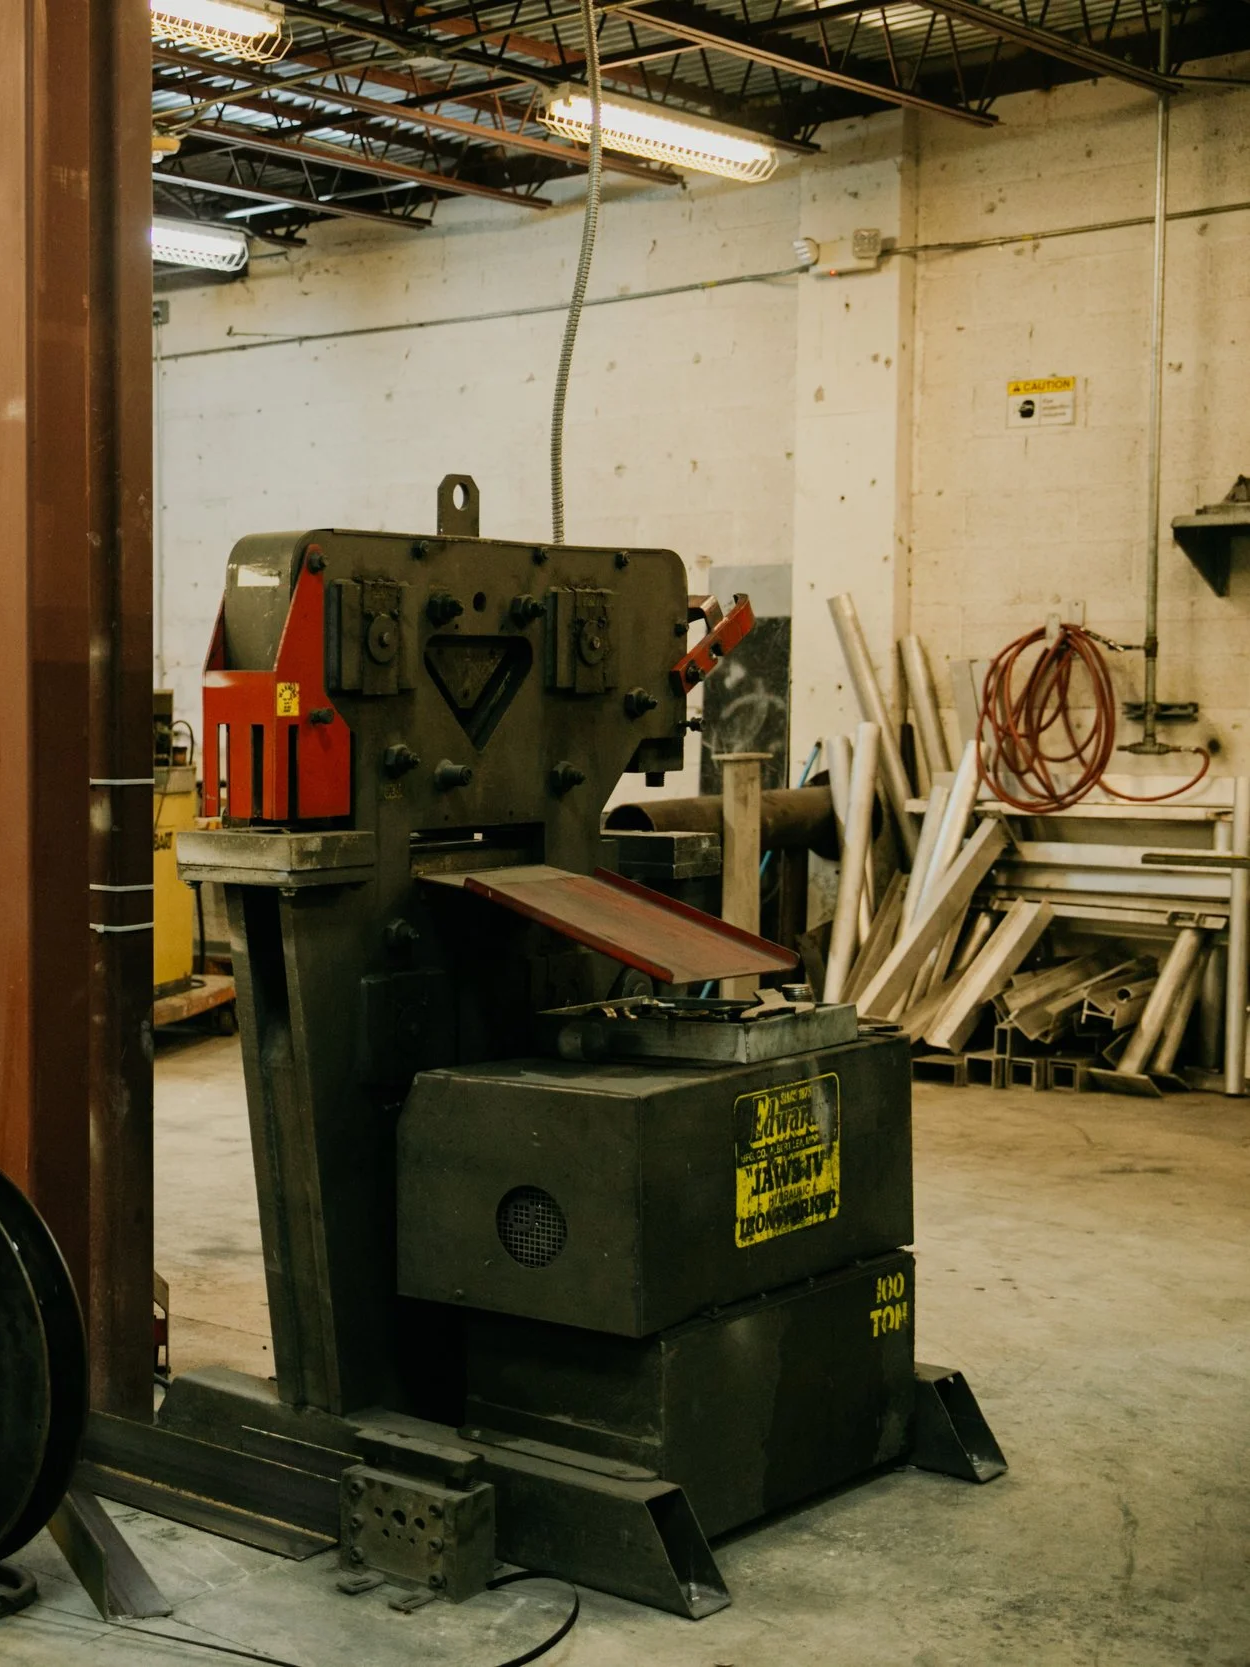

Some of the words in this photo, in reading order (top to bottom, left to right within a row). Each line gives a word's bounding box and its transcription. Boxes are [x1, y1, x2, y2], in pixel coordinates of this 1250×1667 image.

[1024, 380, 1070, 391] CAUTION
[876, 1272, 905, 1303] 100
[870, 1301, 908, 1337] TON
